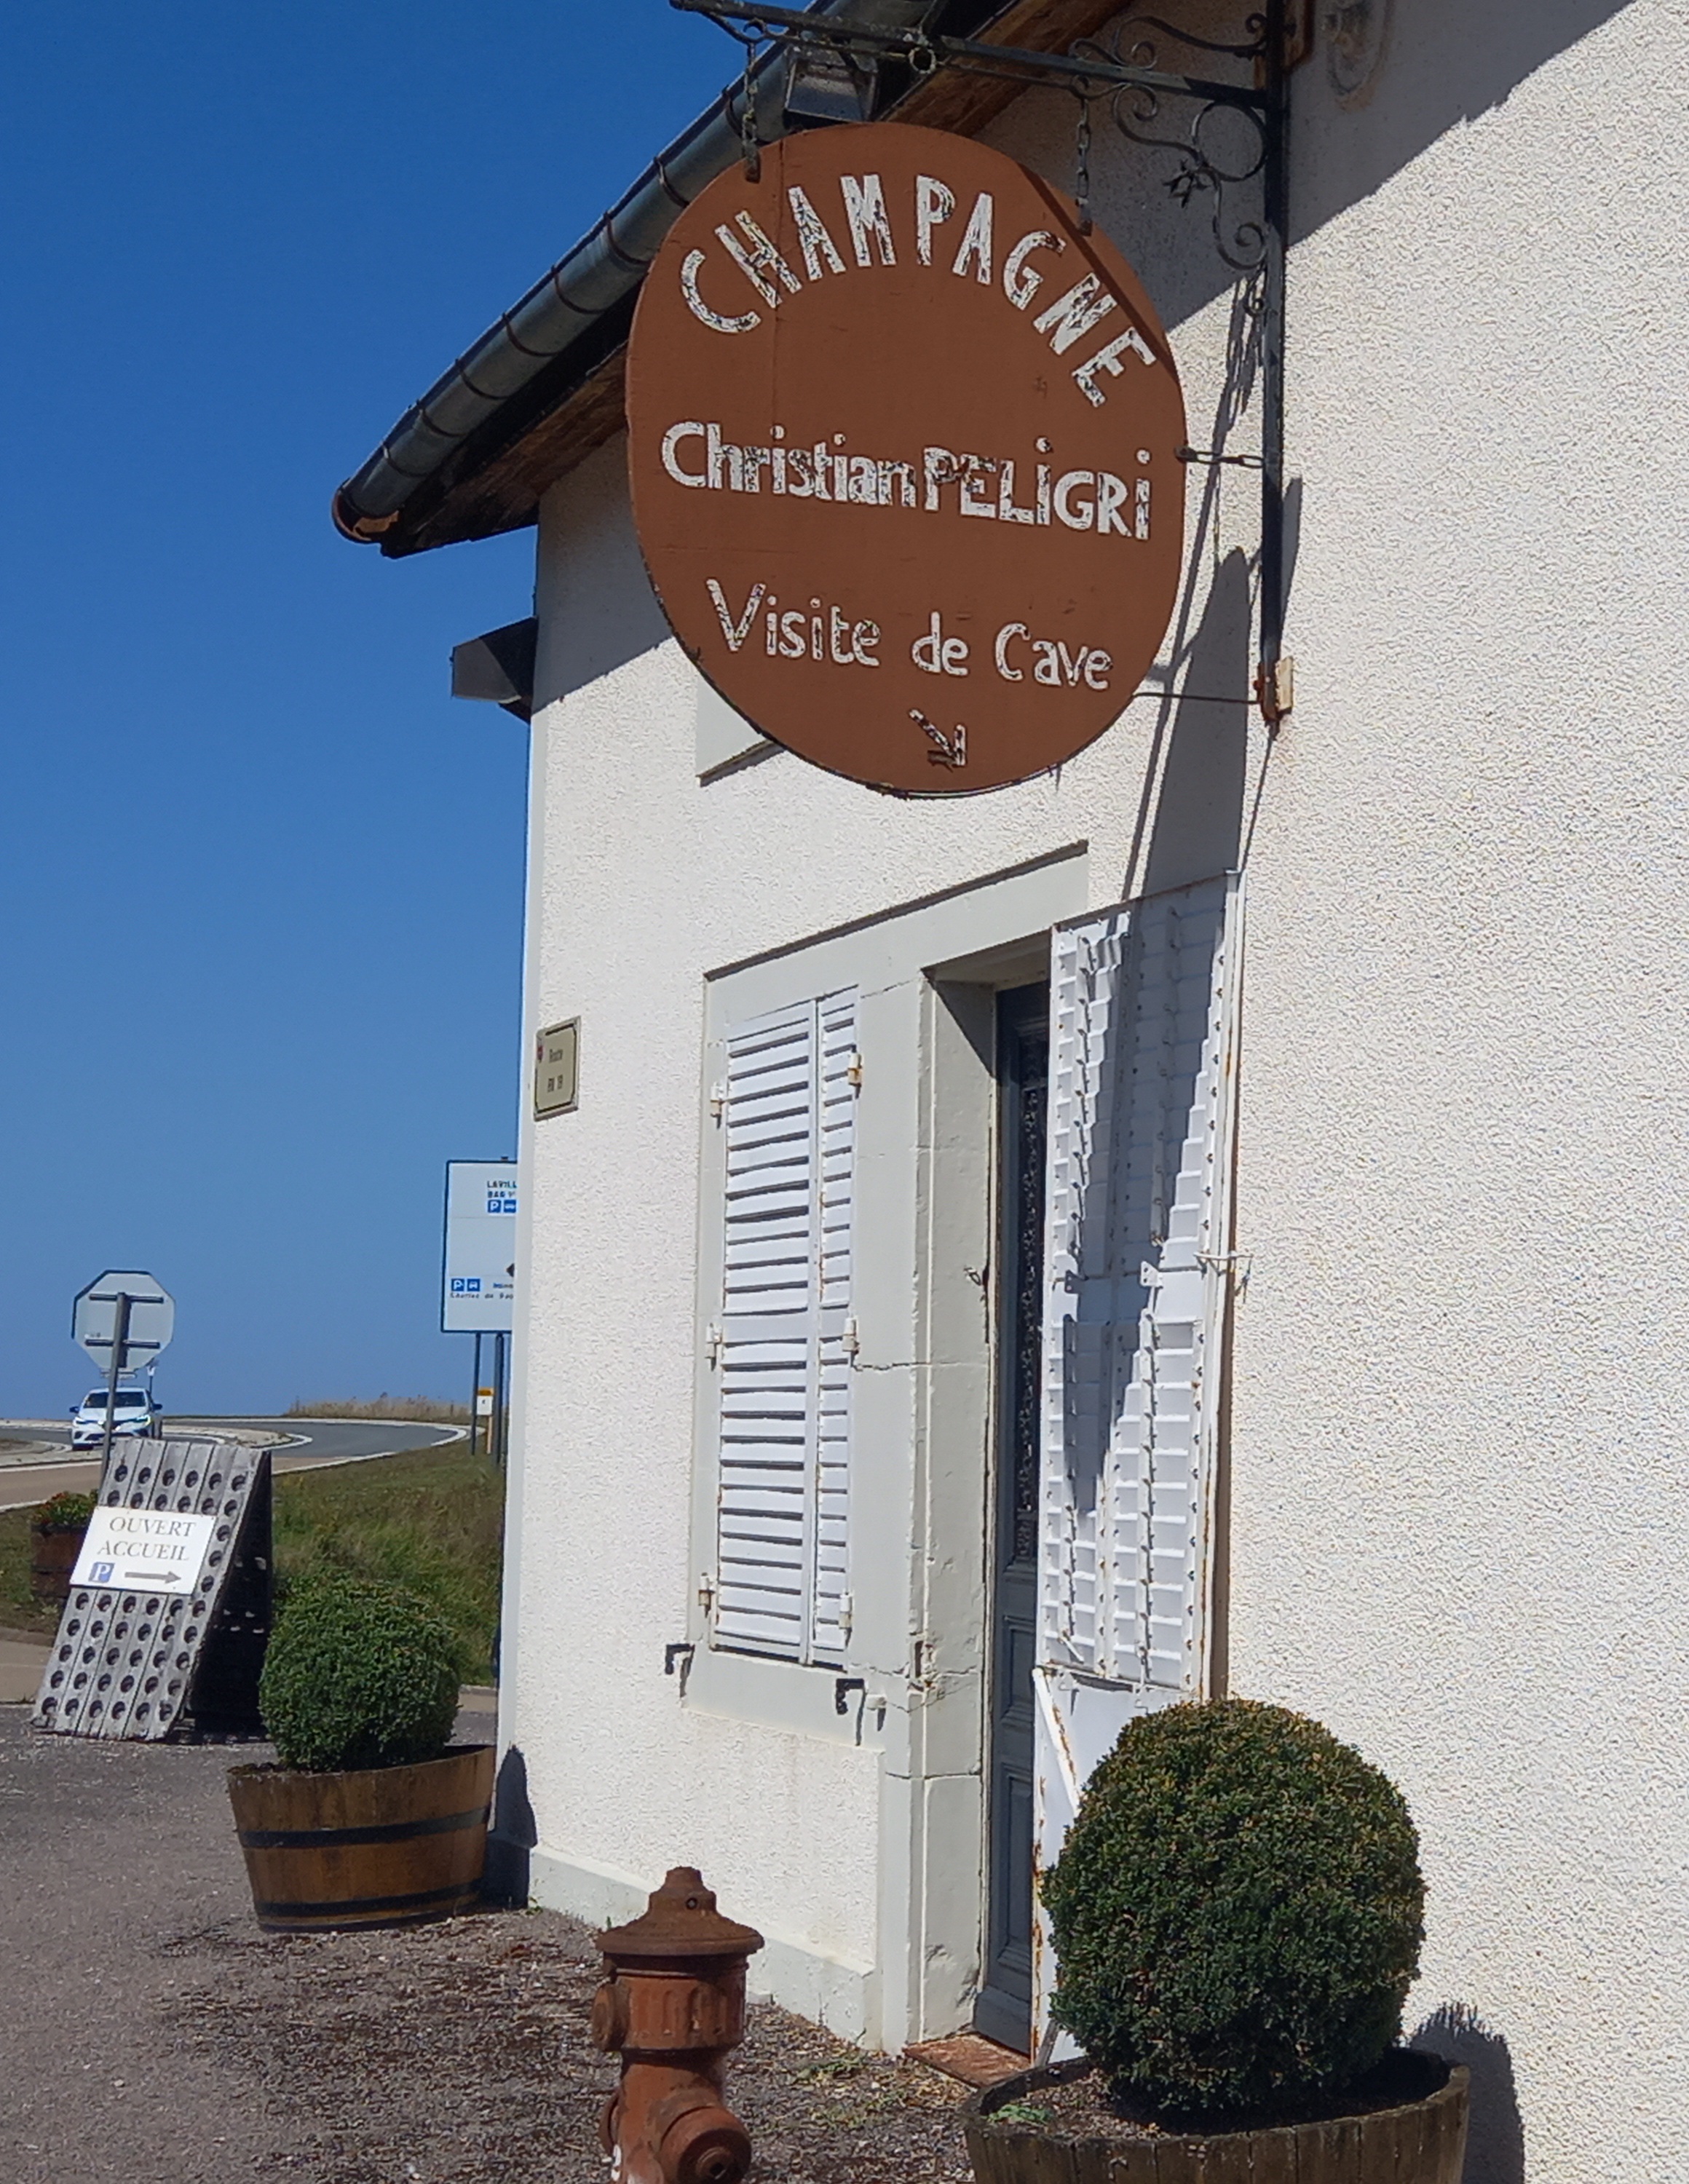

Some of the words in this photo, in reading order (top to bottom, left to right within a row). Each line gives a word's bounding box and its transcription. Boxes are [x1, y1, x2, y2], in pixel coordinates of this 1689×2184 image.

[680, 173, 1157, 407] CHAMPAGNE
[661, 421, 917, 509] Christian
[706, 579, 881, 668] Visite
[911, 612, 969, 677] de
[994, 622, 1112, 691] Cave
[97, 1540, 191, 1562] ACCUEIL
[109, 1516, 197, 1538] OUVERT
